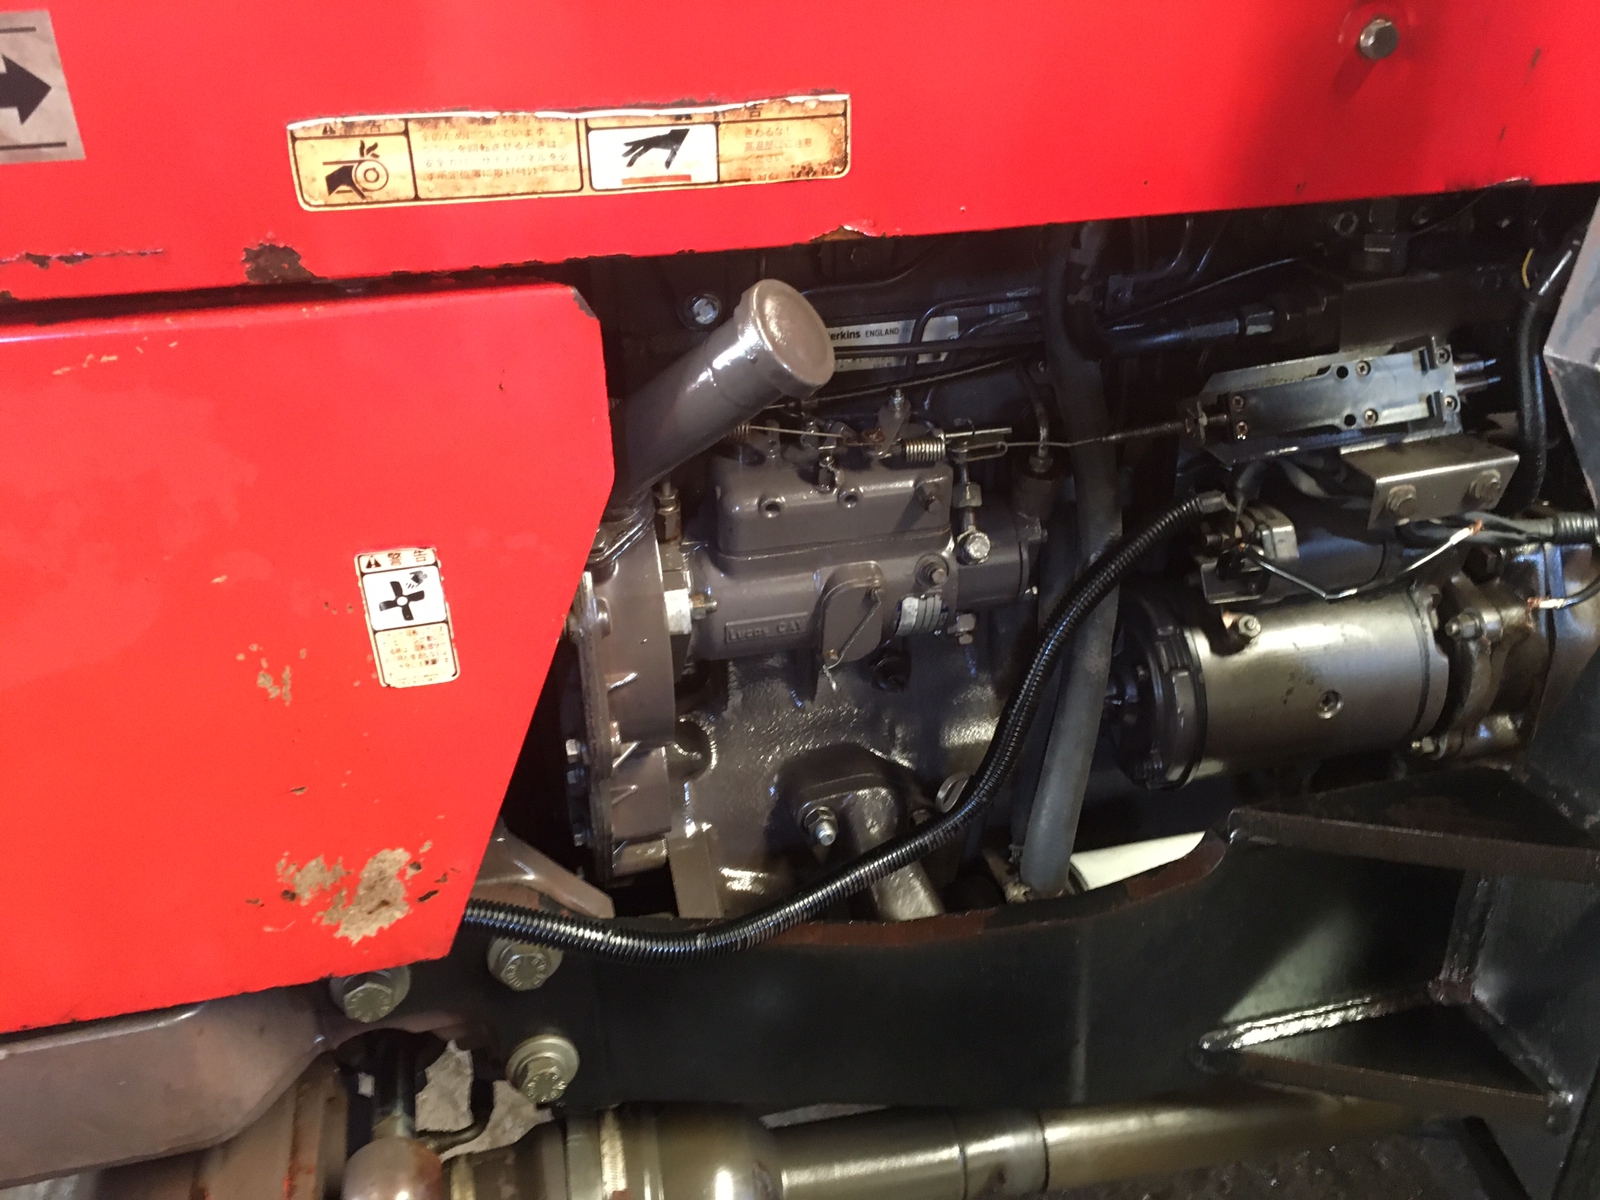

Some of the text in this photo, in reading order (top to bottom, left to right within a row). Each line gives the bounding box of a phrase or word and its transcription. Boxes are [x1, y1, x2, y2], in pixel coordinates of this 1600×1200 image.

[828, 330, 861, 341] erkins
[865, 326, 900, 338] ENGLAND
[387, 549, 427, 566] 警告
